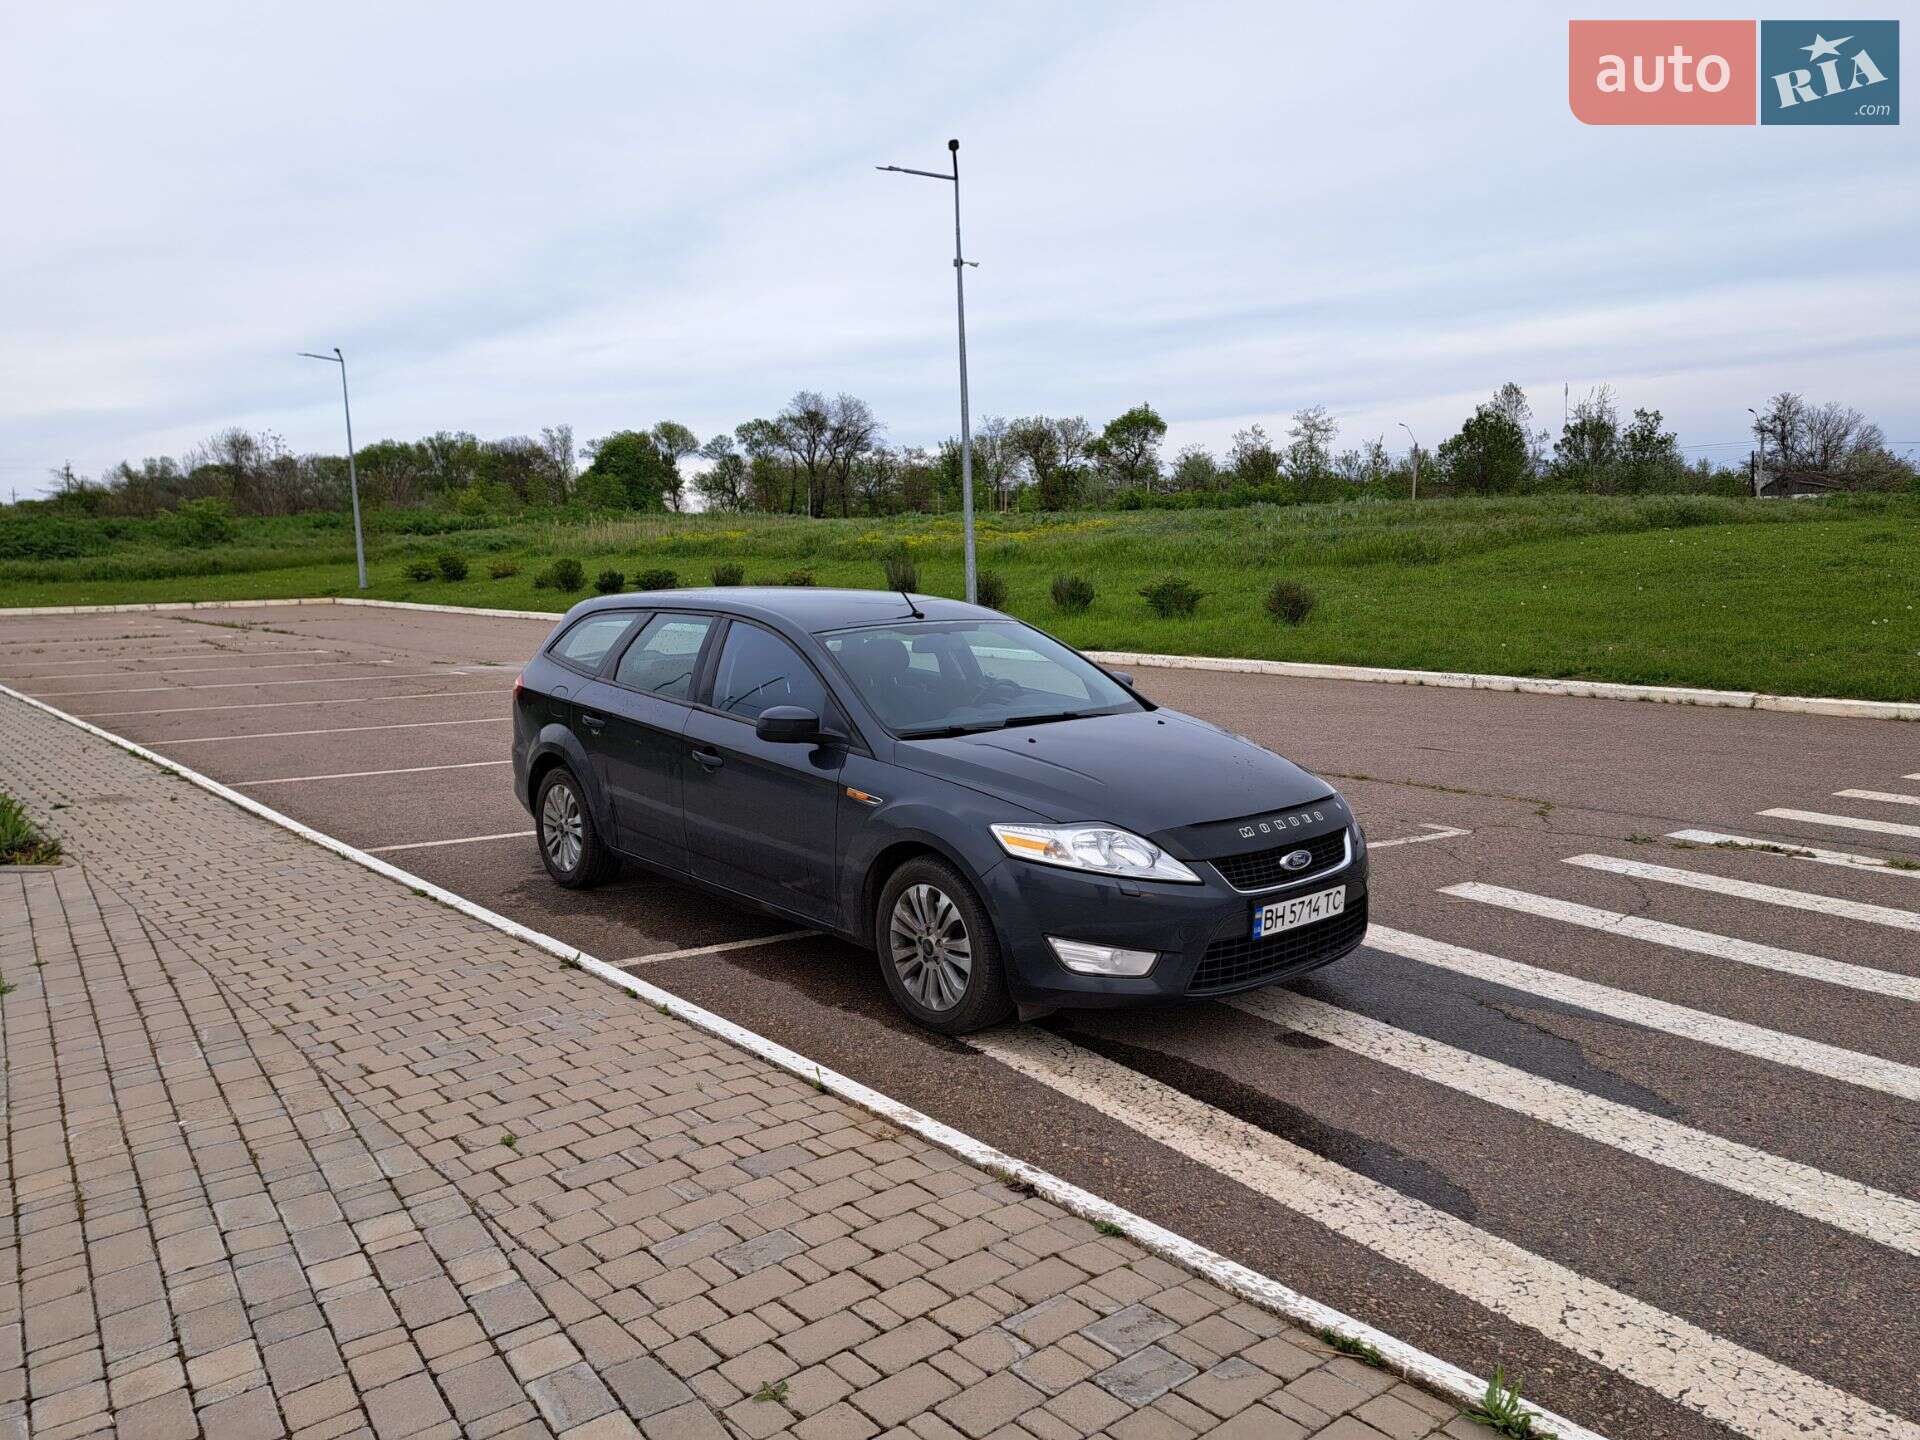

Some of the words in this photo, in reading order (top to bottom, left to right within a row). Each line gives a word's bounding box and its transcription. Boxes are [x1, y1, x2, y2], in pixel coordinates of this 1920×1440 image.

[1238, 811, 1324, 838] MONDEO
[1264, 906, 1286, 931] BH
[1289, 896, 1320, 924] 5714
[1324, 890, 1342, 913] TC
